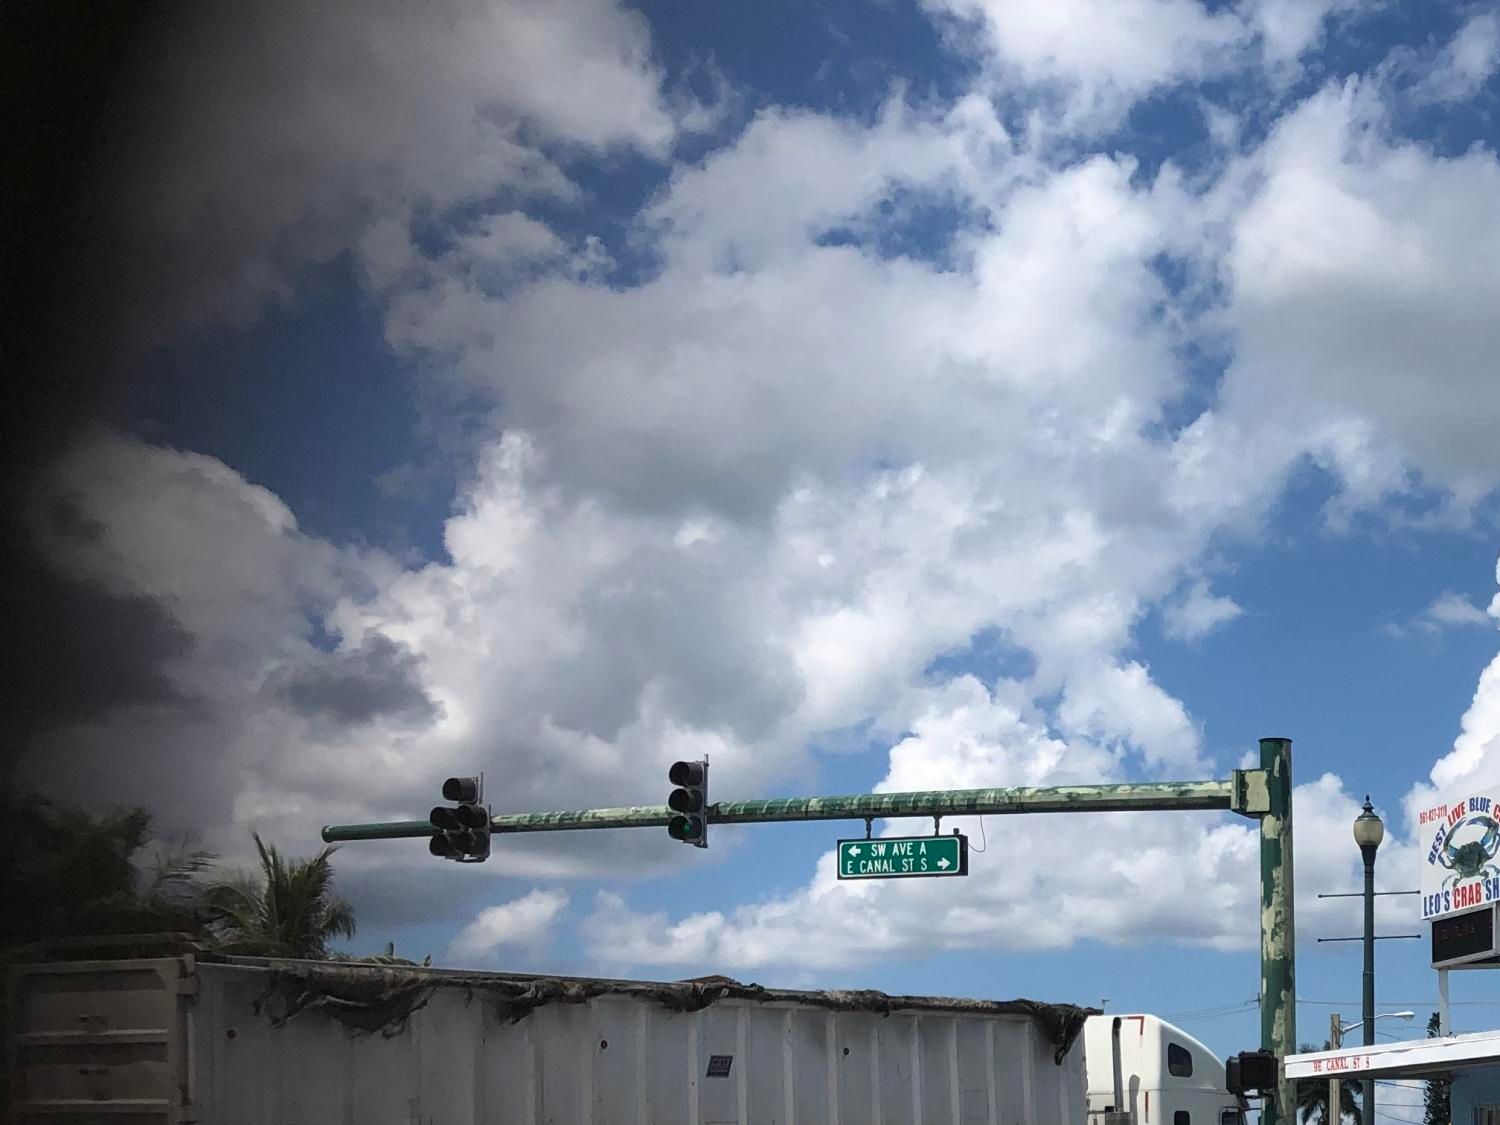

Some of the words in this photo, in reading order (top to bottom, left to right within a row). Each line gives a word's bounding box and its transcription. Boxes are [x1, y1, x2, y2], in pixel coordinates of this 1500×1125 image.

[1428, 824, 1446, 865] BEST
[1447, 801, 1466, 827] LIVE
[1469, 797, 1491, 813] BLUE
[871, 844, 886, 856] SW
[892, 843, 913, 855] AVE
[919, 842, 926, 854] A
[847, 861, 853, 873] E
[859, 859, 895, 873] CANAL
[902, 858, 914, 871] ST
[920, 858, 928, 871] S
[1423, 890, 1450, 916] LEO'S
[1453, 882, 1482, 909] CRAB
[1326, 1057, 1349, 1071] CANAL
[1353, 1056, 1360, 1069] ST
[1365, 1056, 1370, 1068] S
